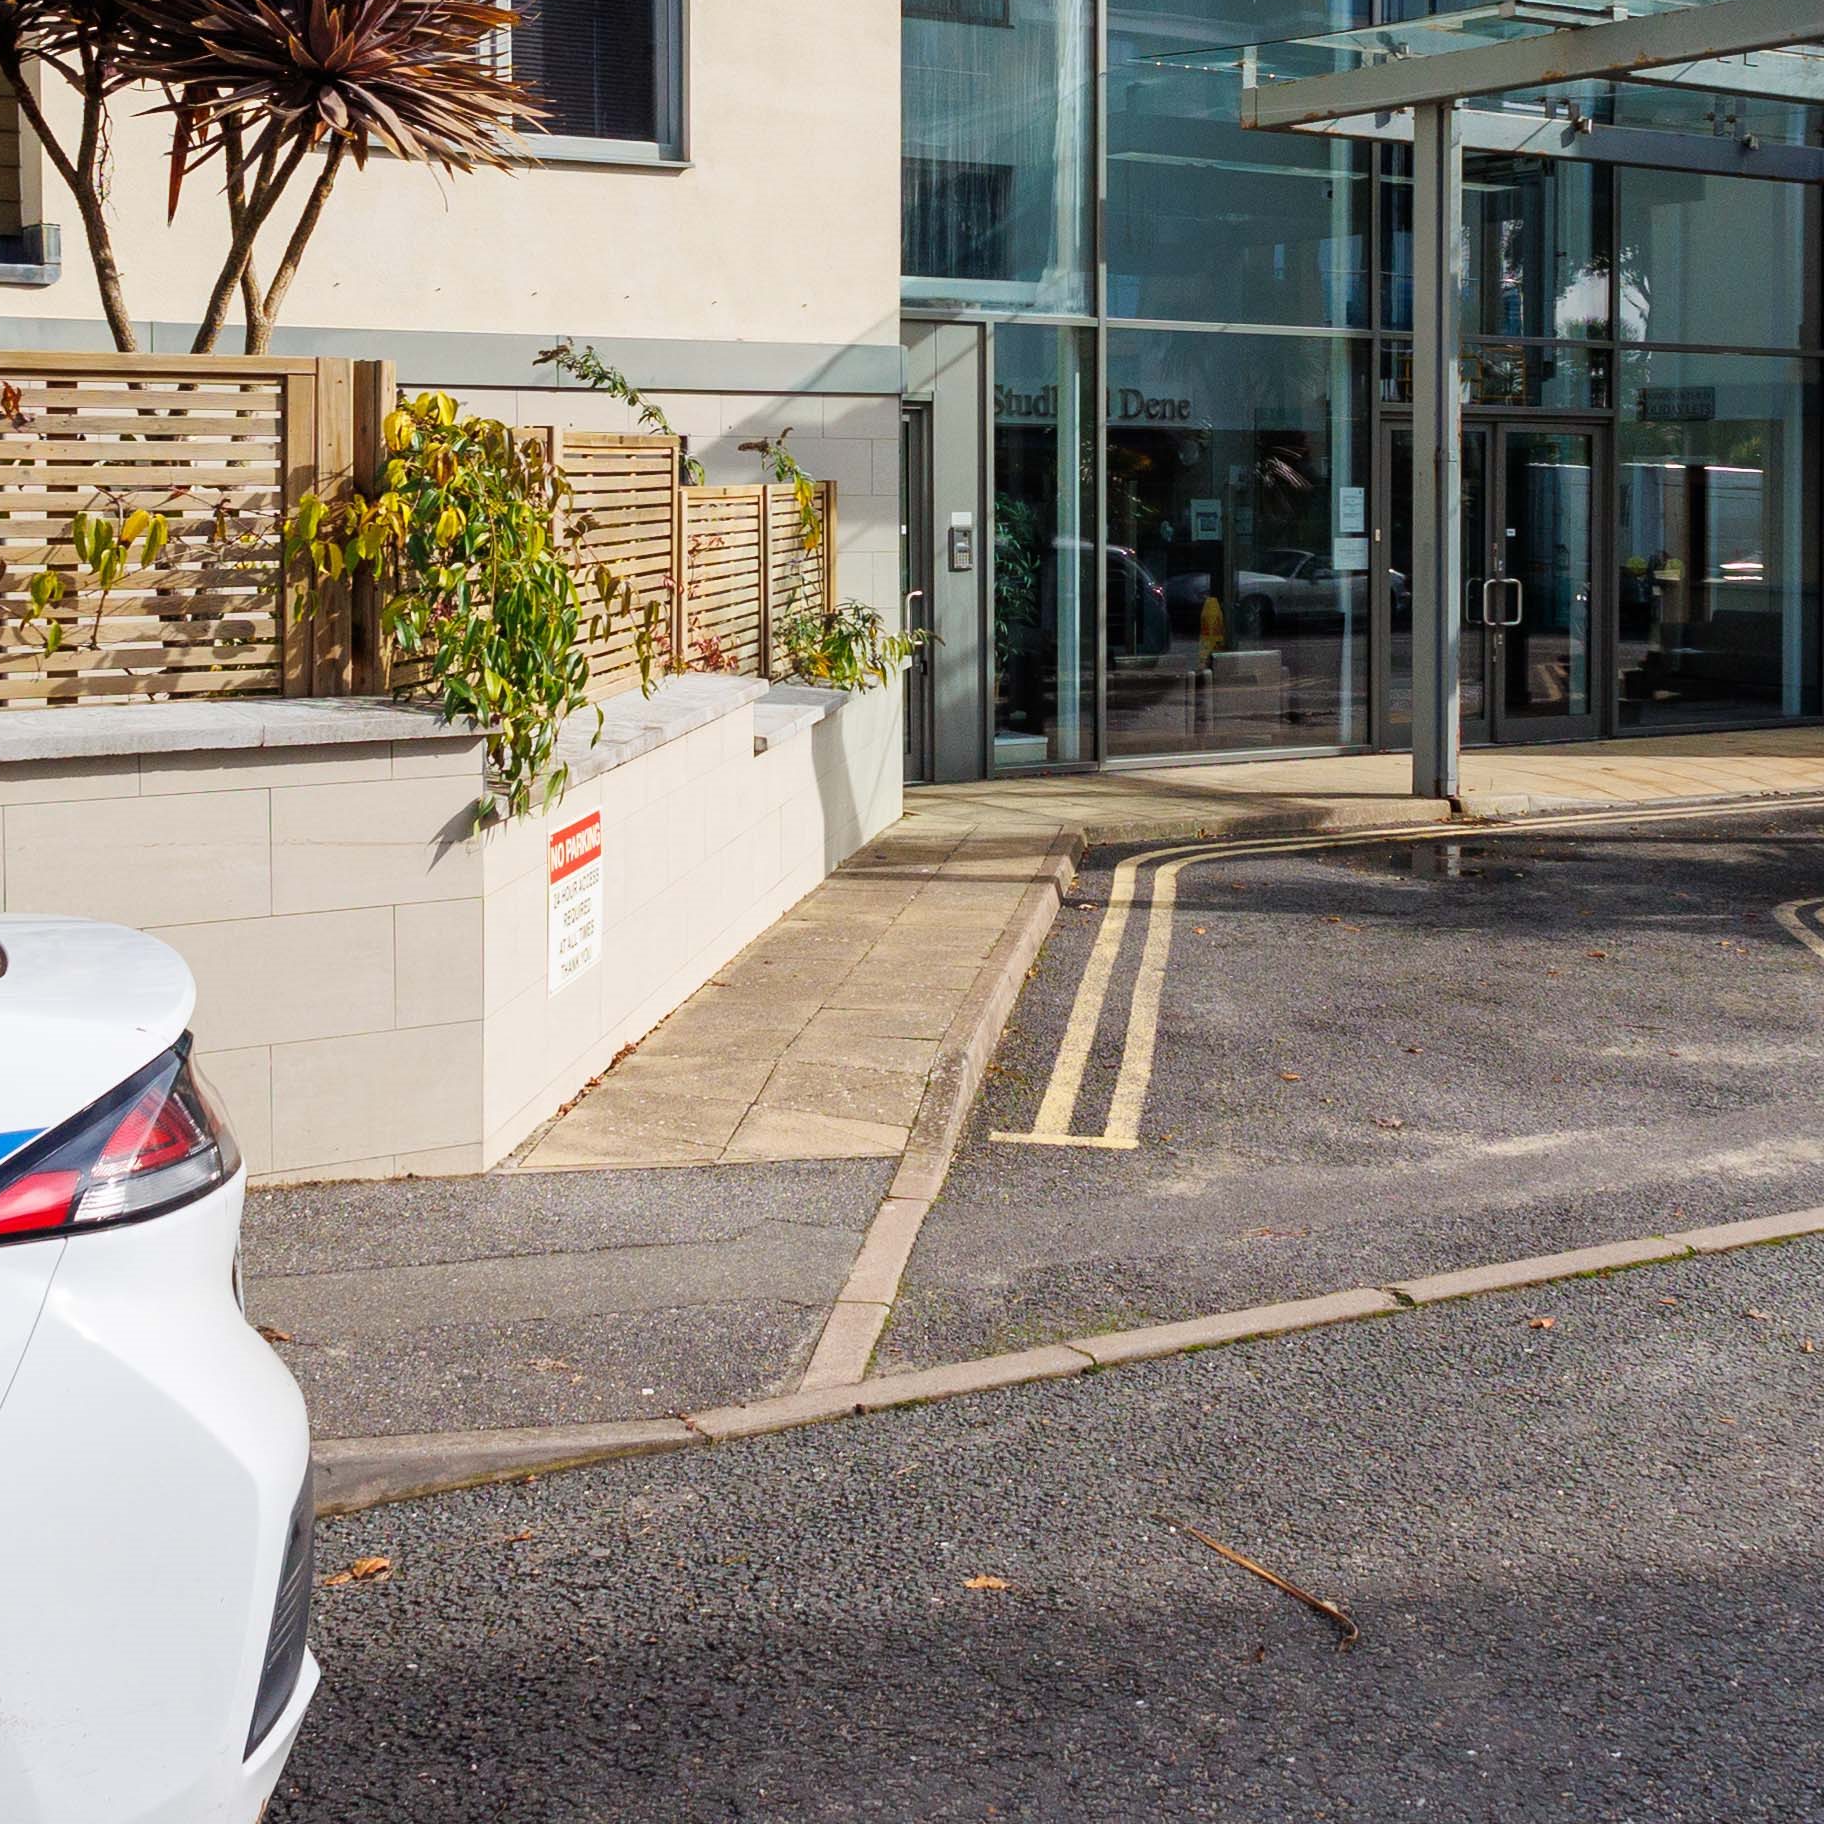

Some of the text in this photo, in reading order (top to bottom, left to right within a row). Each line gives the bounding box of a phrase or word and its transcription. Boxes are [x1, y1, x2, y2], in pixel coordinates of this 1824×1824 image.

[1119, 387, 1192, 421] Dene
[550, 822, 601, 873] NO PARKING
